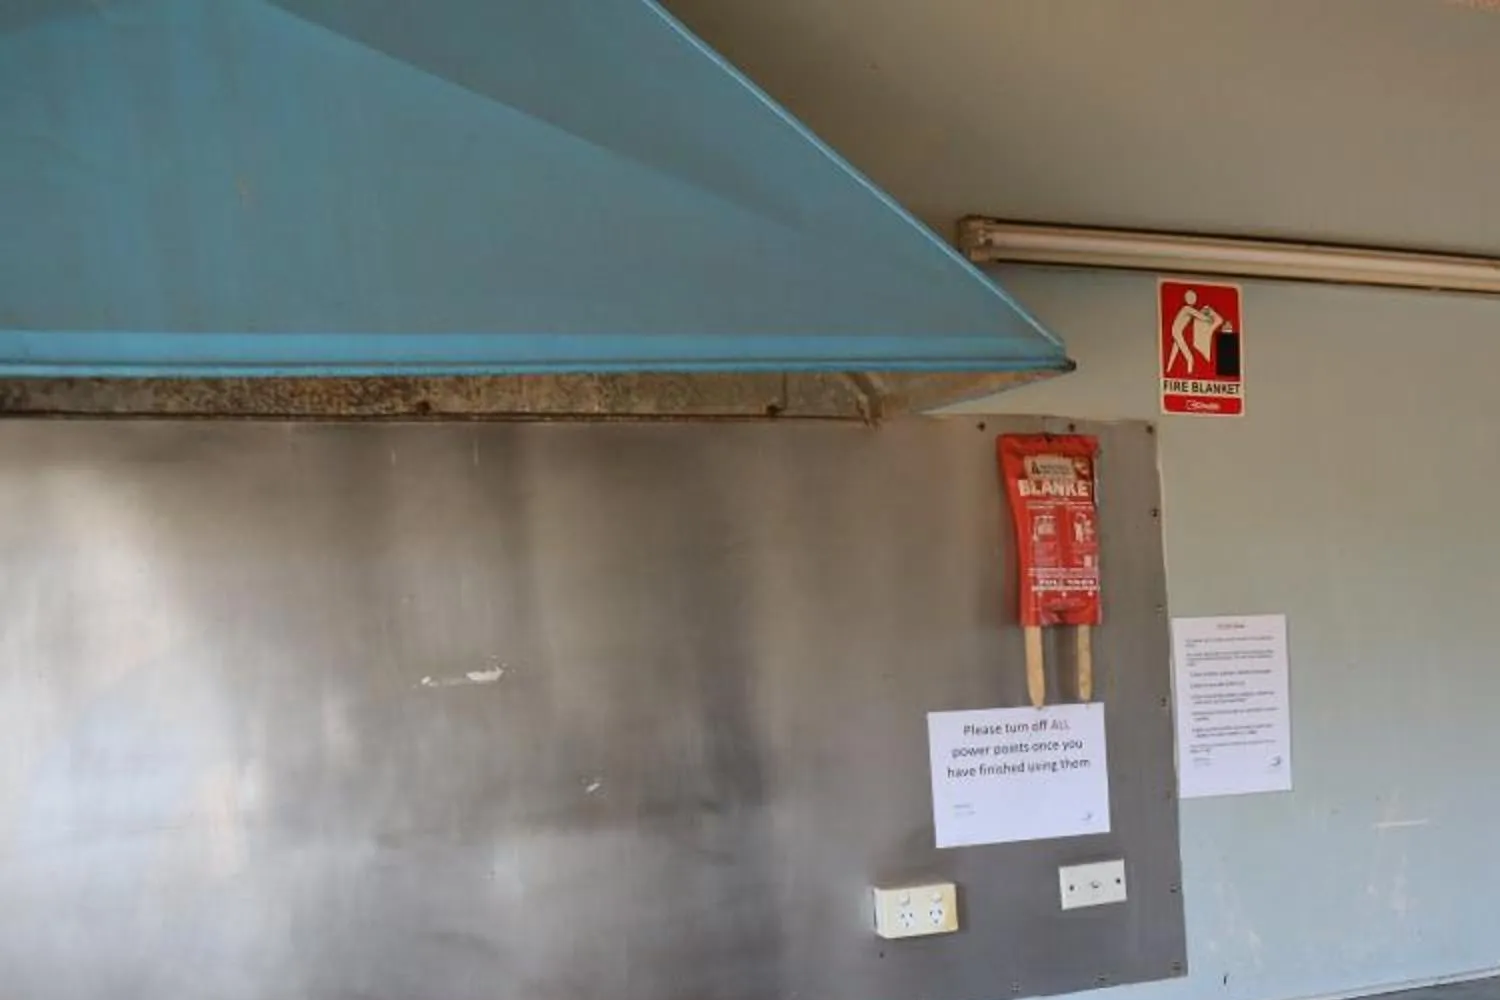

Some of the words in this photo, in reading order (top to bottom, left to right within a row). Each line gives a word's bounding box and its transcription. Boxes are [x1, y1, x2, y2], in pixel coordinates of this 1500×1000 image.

[1163, 380, 1188, 392] FIRE
[1191, 381, 1241, 394] BLANKET
[963, 723, 1003, 736] Please
[1005, 723, 1030, 734] turn
[1031, 720, 1048, 732] off
[1050, 719, 1071, 731] ALL
[952, 746, 990, 759] power
[993, 743, 1030, 755] points
[1031, 740, 1060, 751] once
[1061, 739, 1084, 751] you
[947, 766, 977, 778] have
[979, 762, 1025, 776] finished
[1027, 761, 1057, 773] using
[1060, 758, 1091, 770] them
